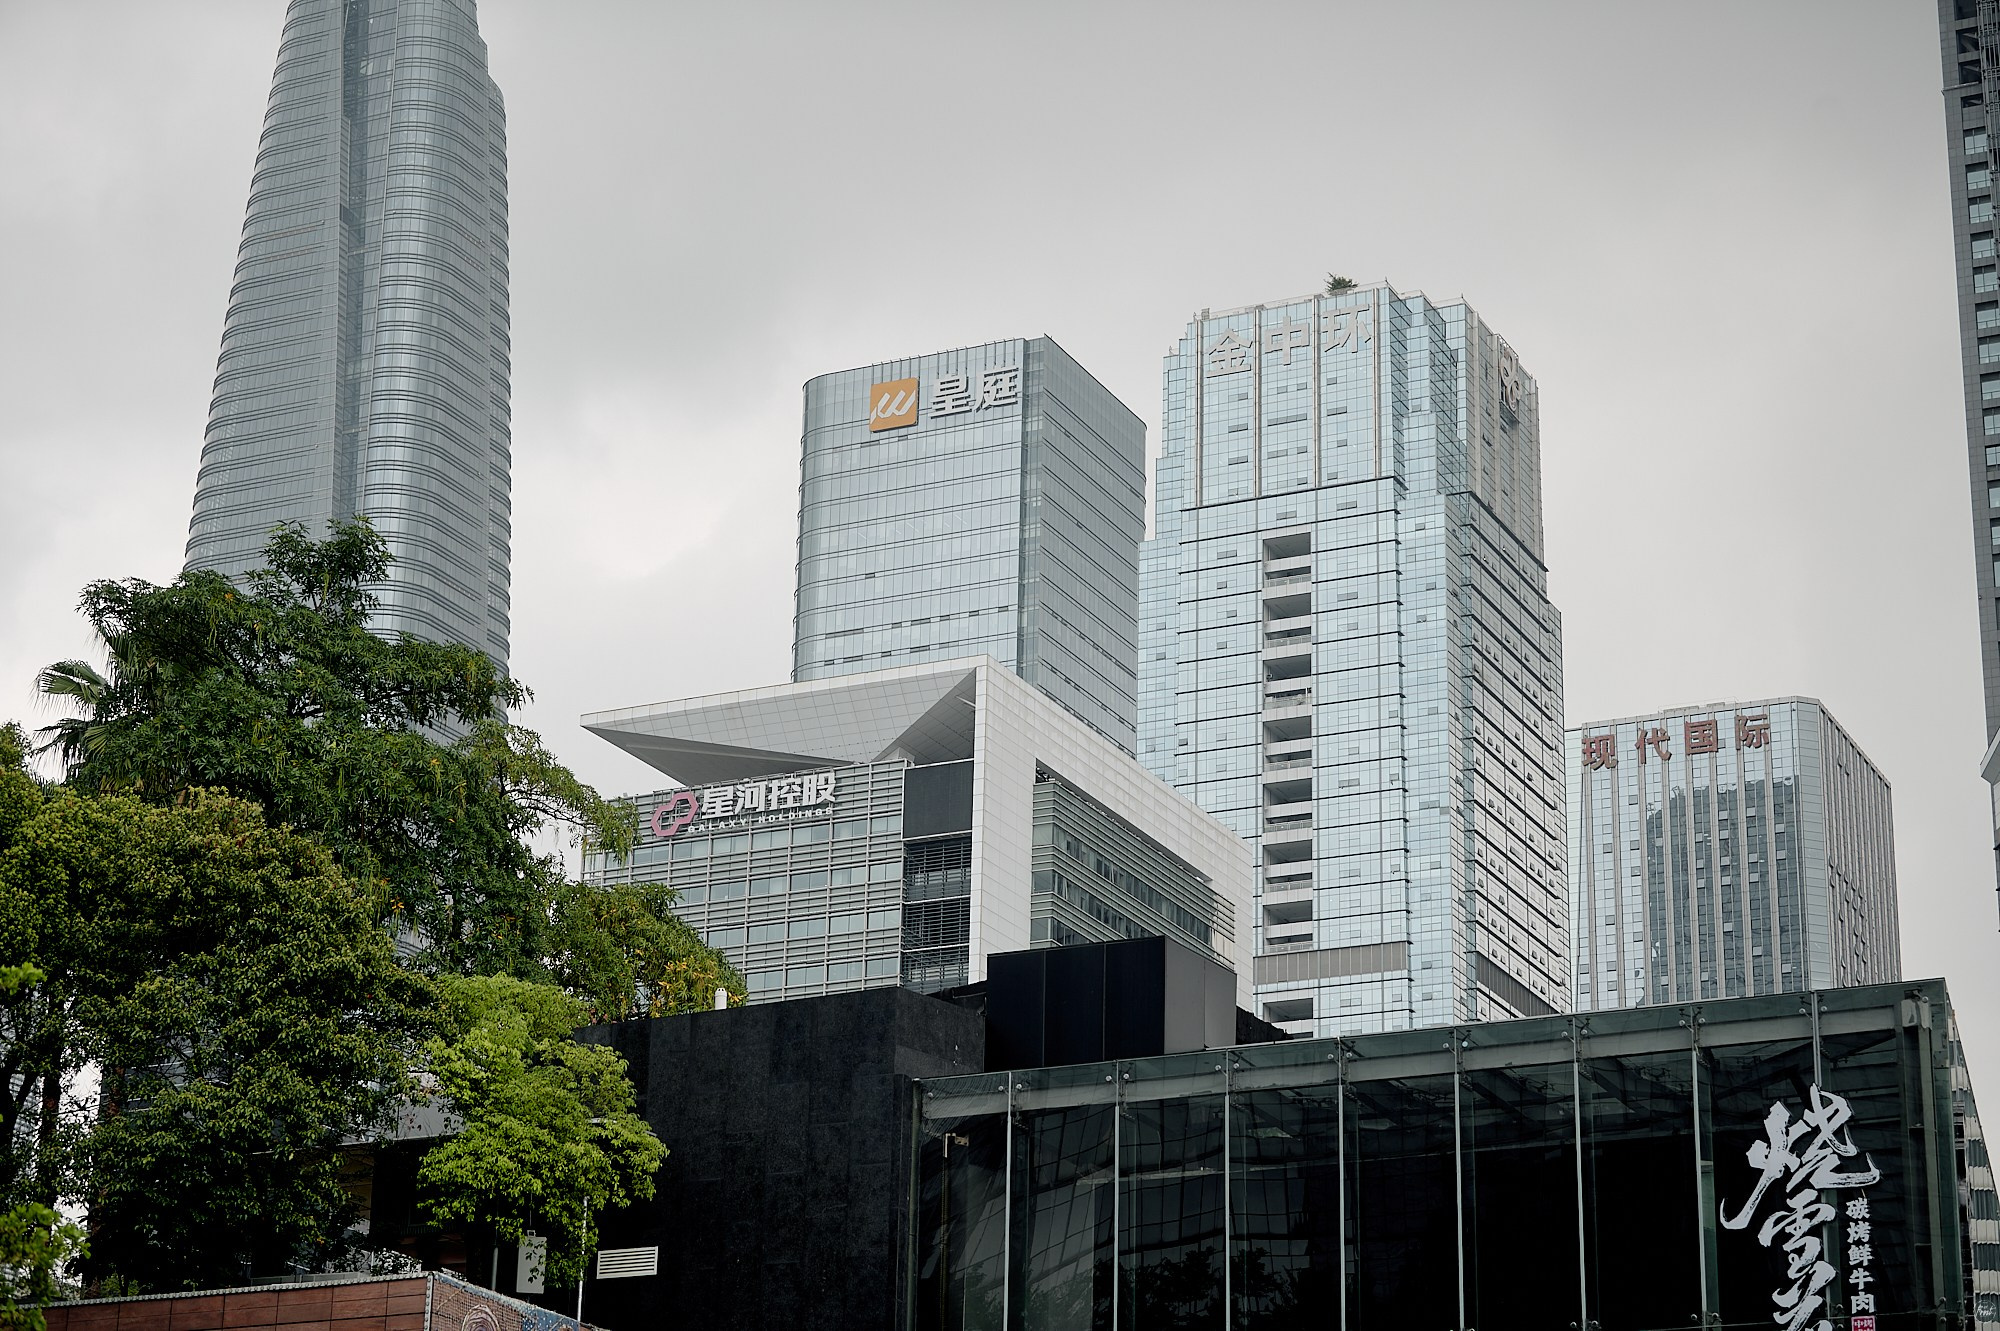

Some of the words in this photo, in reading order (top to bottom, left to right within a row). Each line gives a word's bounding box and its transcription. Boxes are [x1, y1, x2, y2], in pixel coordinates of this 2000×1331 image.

[1206, 303, 1373, 379] 金中环
[928, 366, 1020, 420] 皇庭
[1581, 713, 1770, 771] 现代国际
[687, 818, 747, 833] GALAXY
[758, 806, 833, 824] HOLDINGS
[701, 772, 836, 819] 星河控股
[1846, 1197, 1876, 1314] 碳烤鲜牛肉
